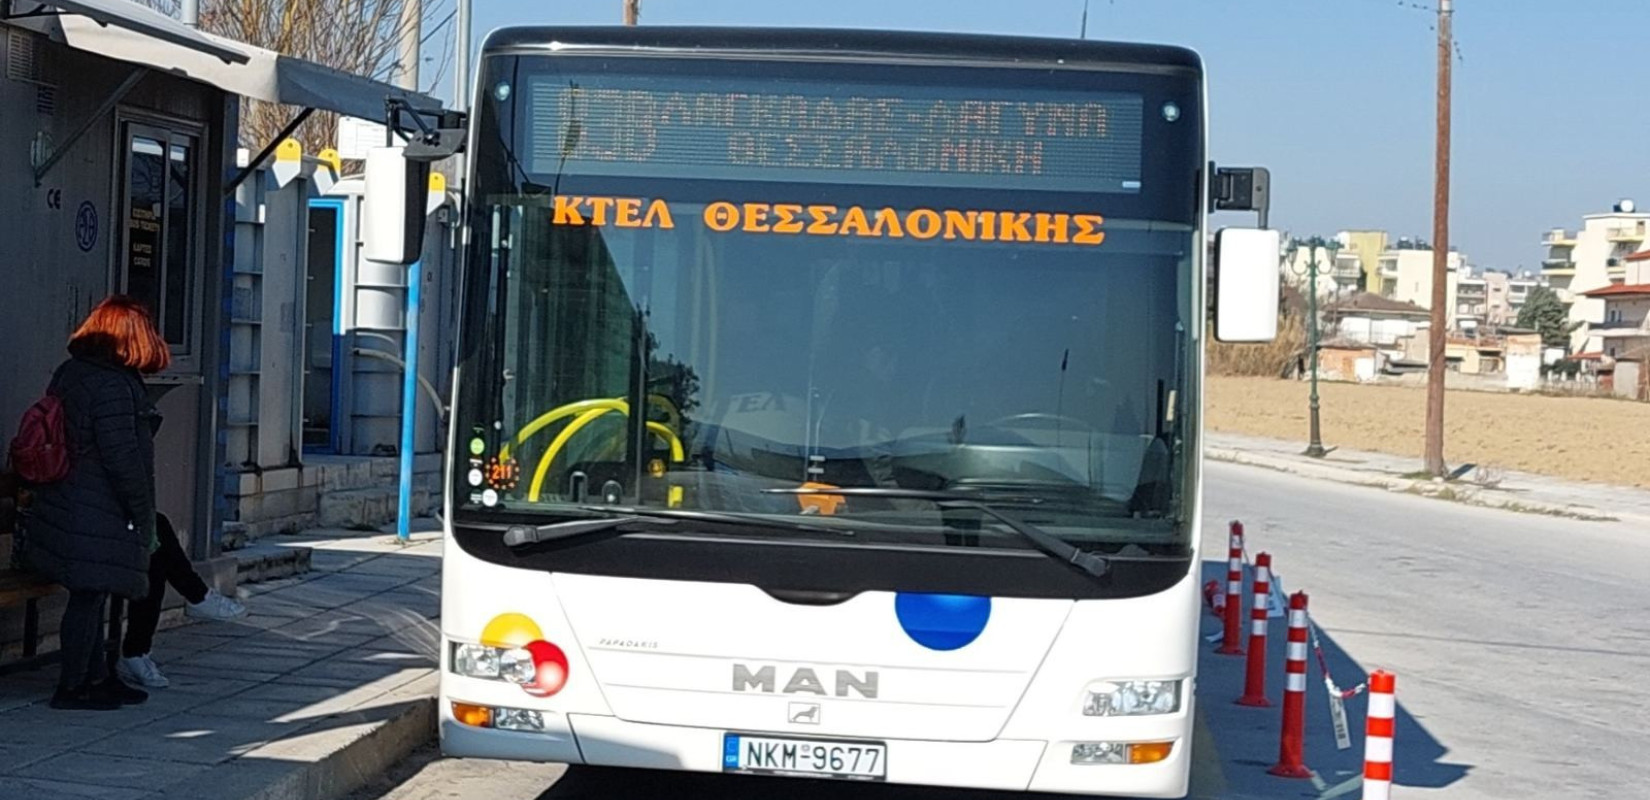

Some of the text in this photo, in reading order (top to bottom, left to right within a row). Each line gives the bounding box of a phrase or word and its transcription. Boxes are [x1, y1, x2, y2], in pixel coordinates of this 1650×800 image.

[728, 131, 1043, 175] ΘΕΣΣΑΛΟΝΙΚΗ
[552, 195, 1106, 245] ΚΤΕΛ ΘΕΣΣΑΛΟΝΙΚΗΣ
[492, 464, 513, 480] 211
[599, 638, 658, 648] PAPADAKIS
[732, 663, 879, 699] MAN
[747, 741, 880, 774] NKM-9677
